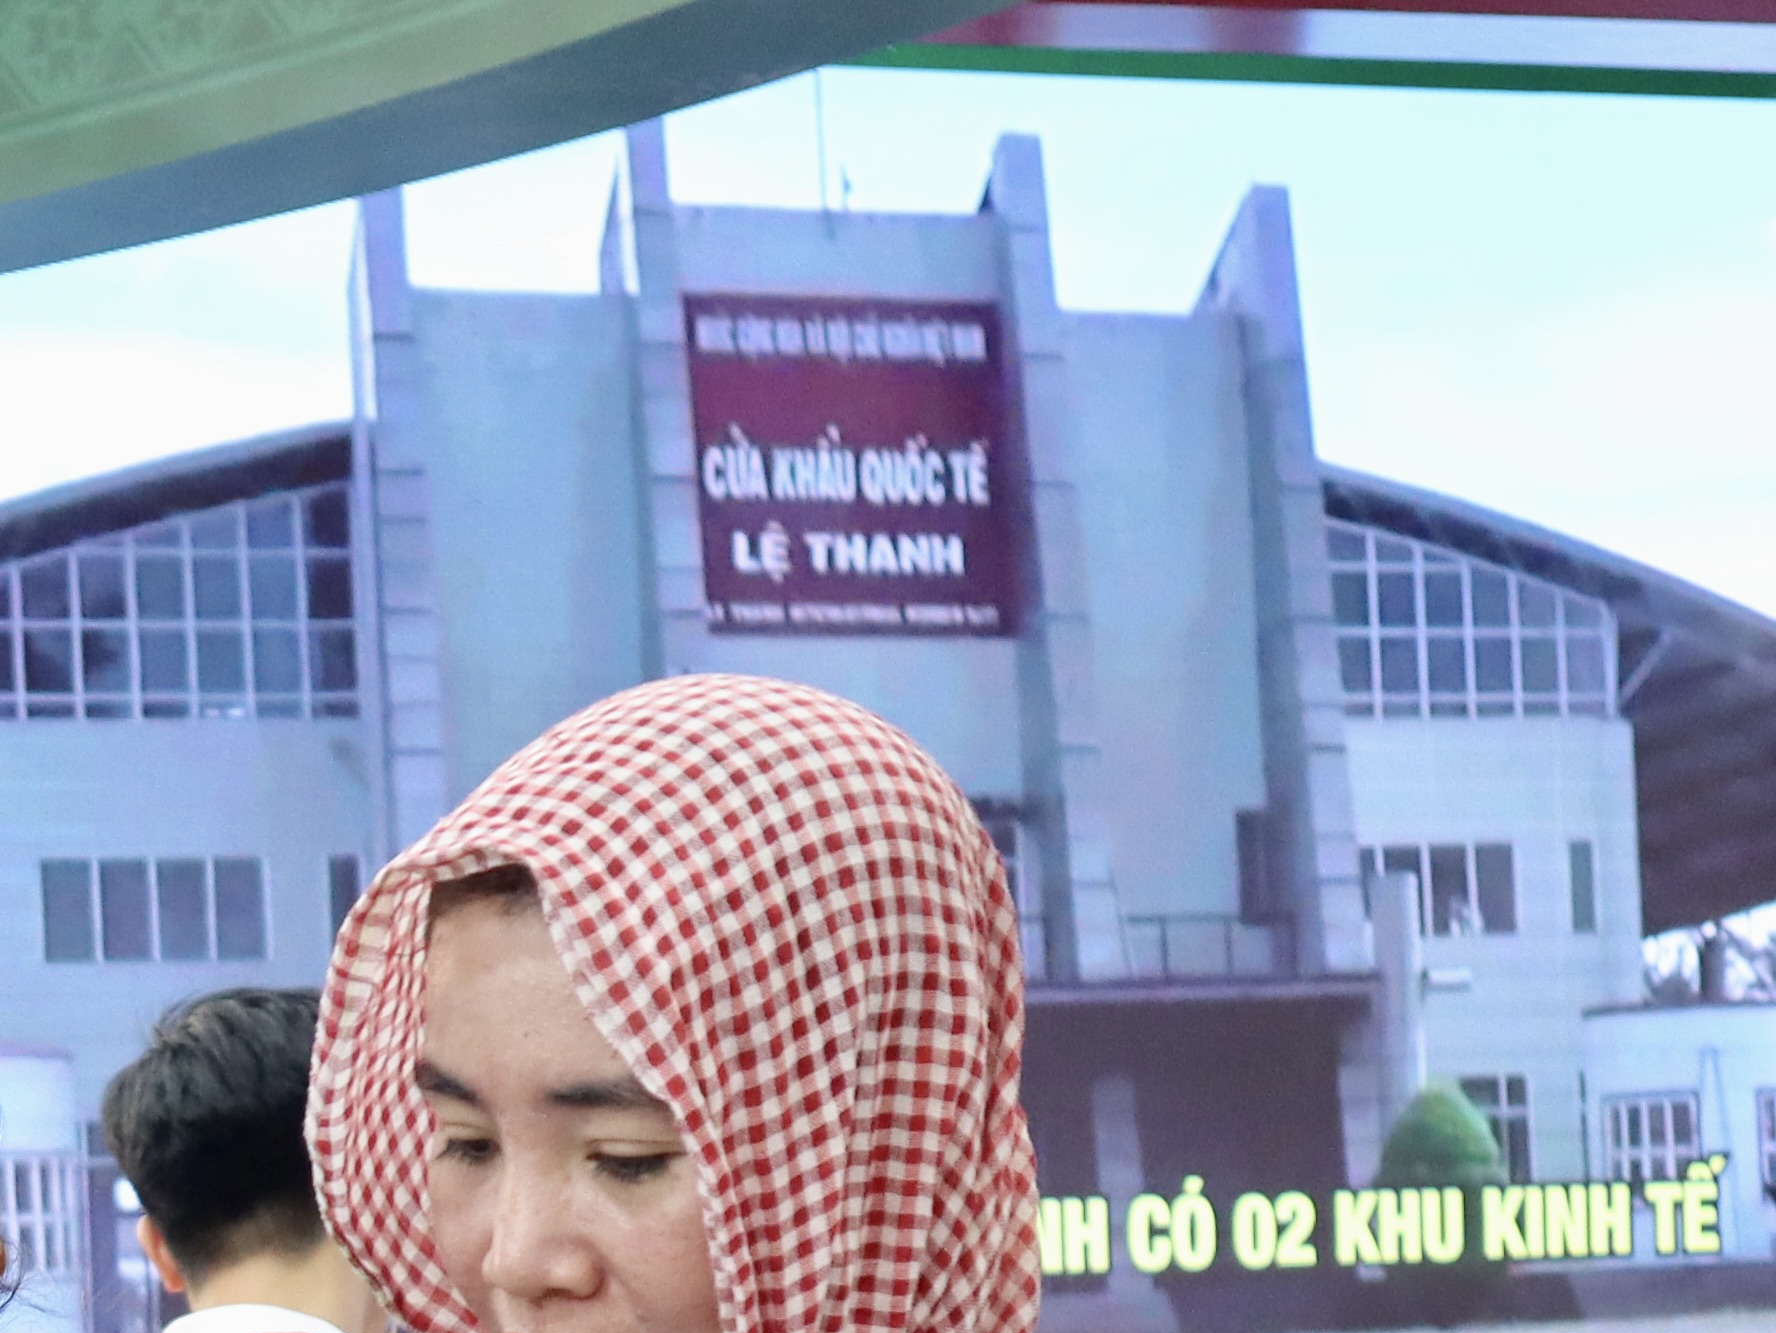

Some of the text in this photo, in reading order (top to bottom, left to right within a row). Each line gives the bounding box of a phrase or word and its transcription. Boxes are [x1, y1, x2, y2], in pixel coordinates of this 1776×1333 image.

[859, 433, 946, 506] QUỐC
[948, 439, 990, 506] TẾ
[732, 520, 965, 584] LỆ THANH
[1037, 1155, 1731, 1276] NH CÓ 02 KHU KINH TẾ
